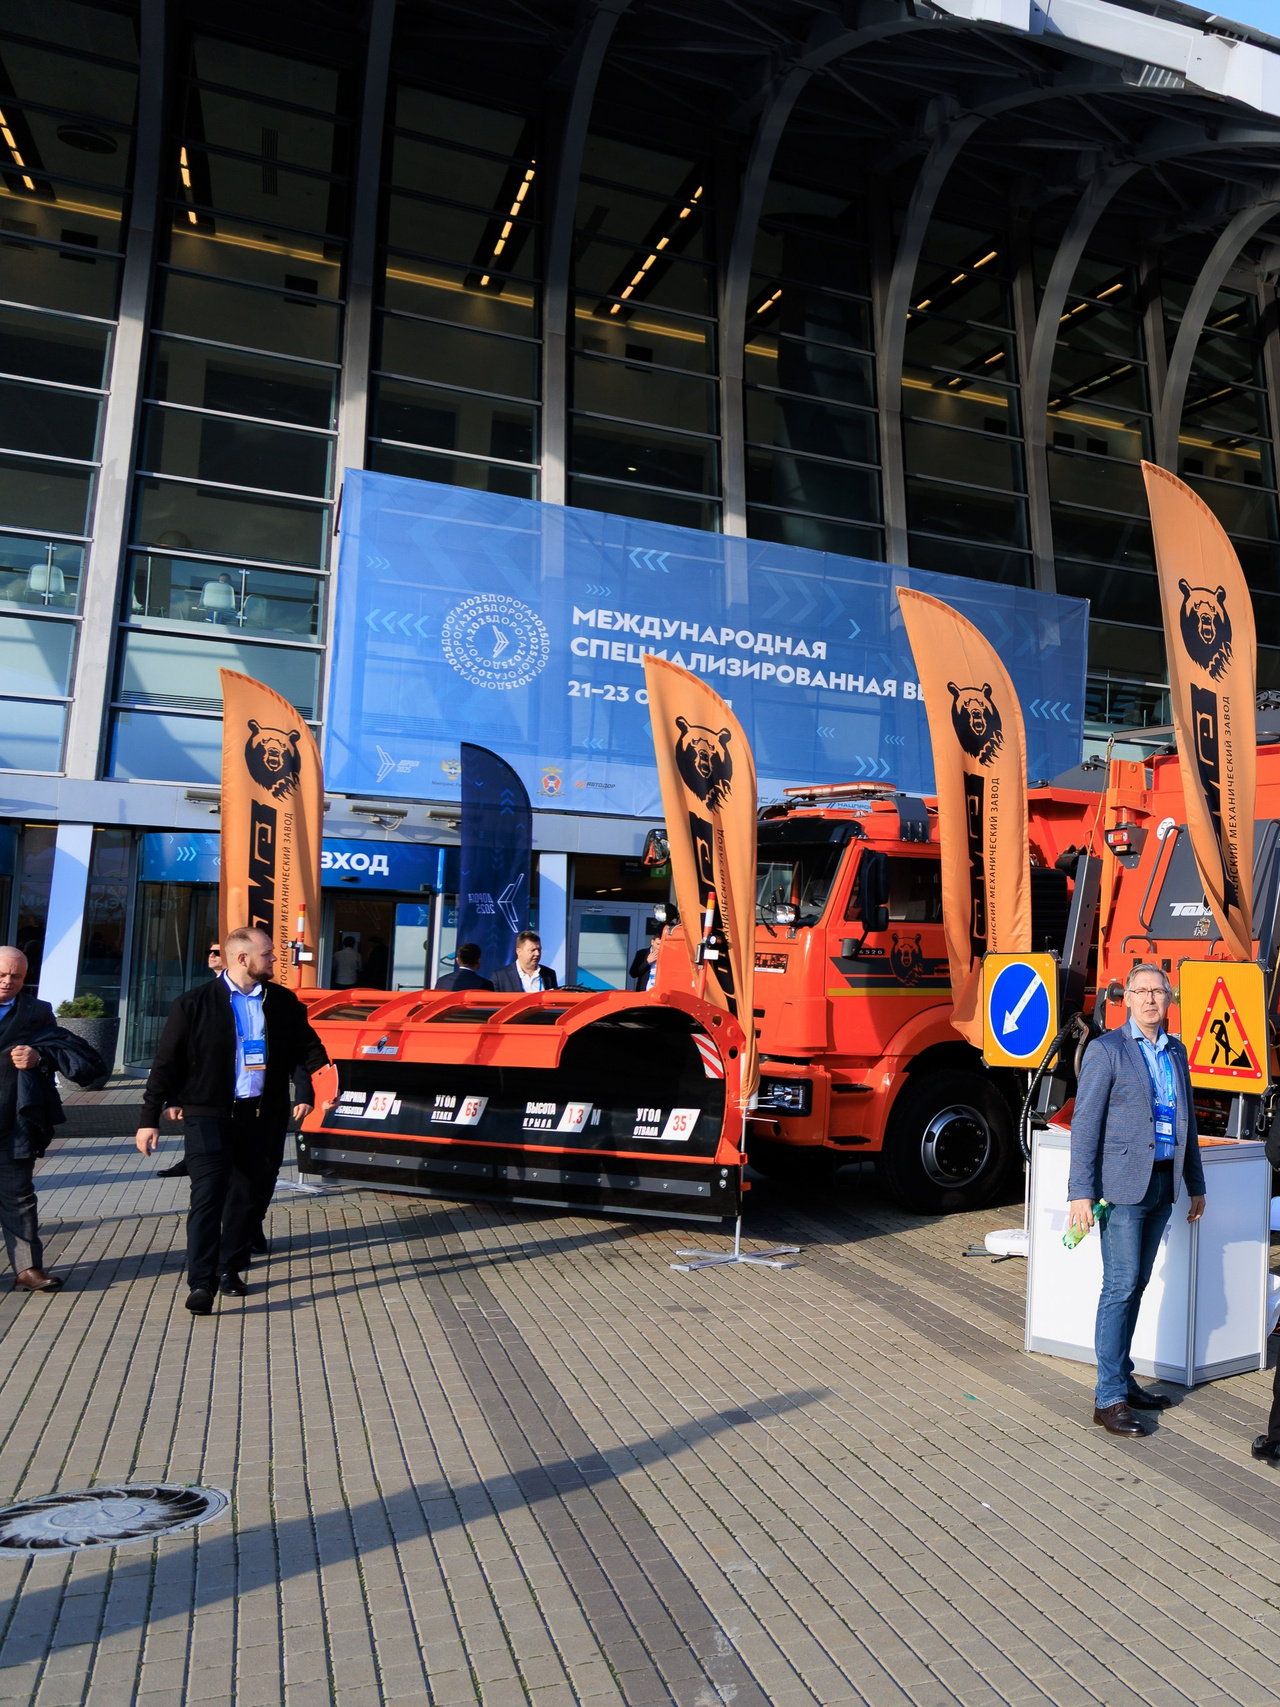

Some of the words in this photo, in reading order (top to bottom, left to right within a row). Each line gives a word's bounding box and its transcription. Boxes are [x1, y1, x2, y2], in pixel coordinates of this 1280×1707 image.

[572, 605, 827, 660] МЕЖДУНАРОДНАЯ
[570, 637, 897, 697] СПЕЦИАЛИЗИРОВАННАЯ
[1222, 696, 1231, 736] ЗАВОД
[990, 777, 1000, 812] ЗАВОД
[1225, 739, 1238, 838] МЕХАНИЧЕСКИЙ
[283, 812, 293, 844] ЗАВОД
[989, 816, 998, 899] МЕХАНИЧЕСКИЙ
[281, 846, 291, 922] МЕХАНИЧЕСКИЙ
[372, 1097, 387, 1111] 3.5
[434, 1095, 456, 1108] УГОЛ
[526, 1102, 556, 1115] ВЫСОТА
[431, 1111, 453, 1120] АТАКИ
[522, 1118, 552, 1128] КРЫЛА
[568, 1108, 584, 1124] 1.3
[636, 1108, 662, 1122] УГОЛ
[633, 1126, 658, 1136] ОТВАЛА
